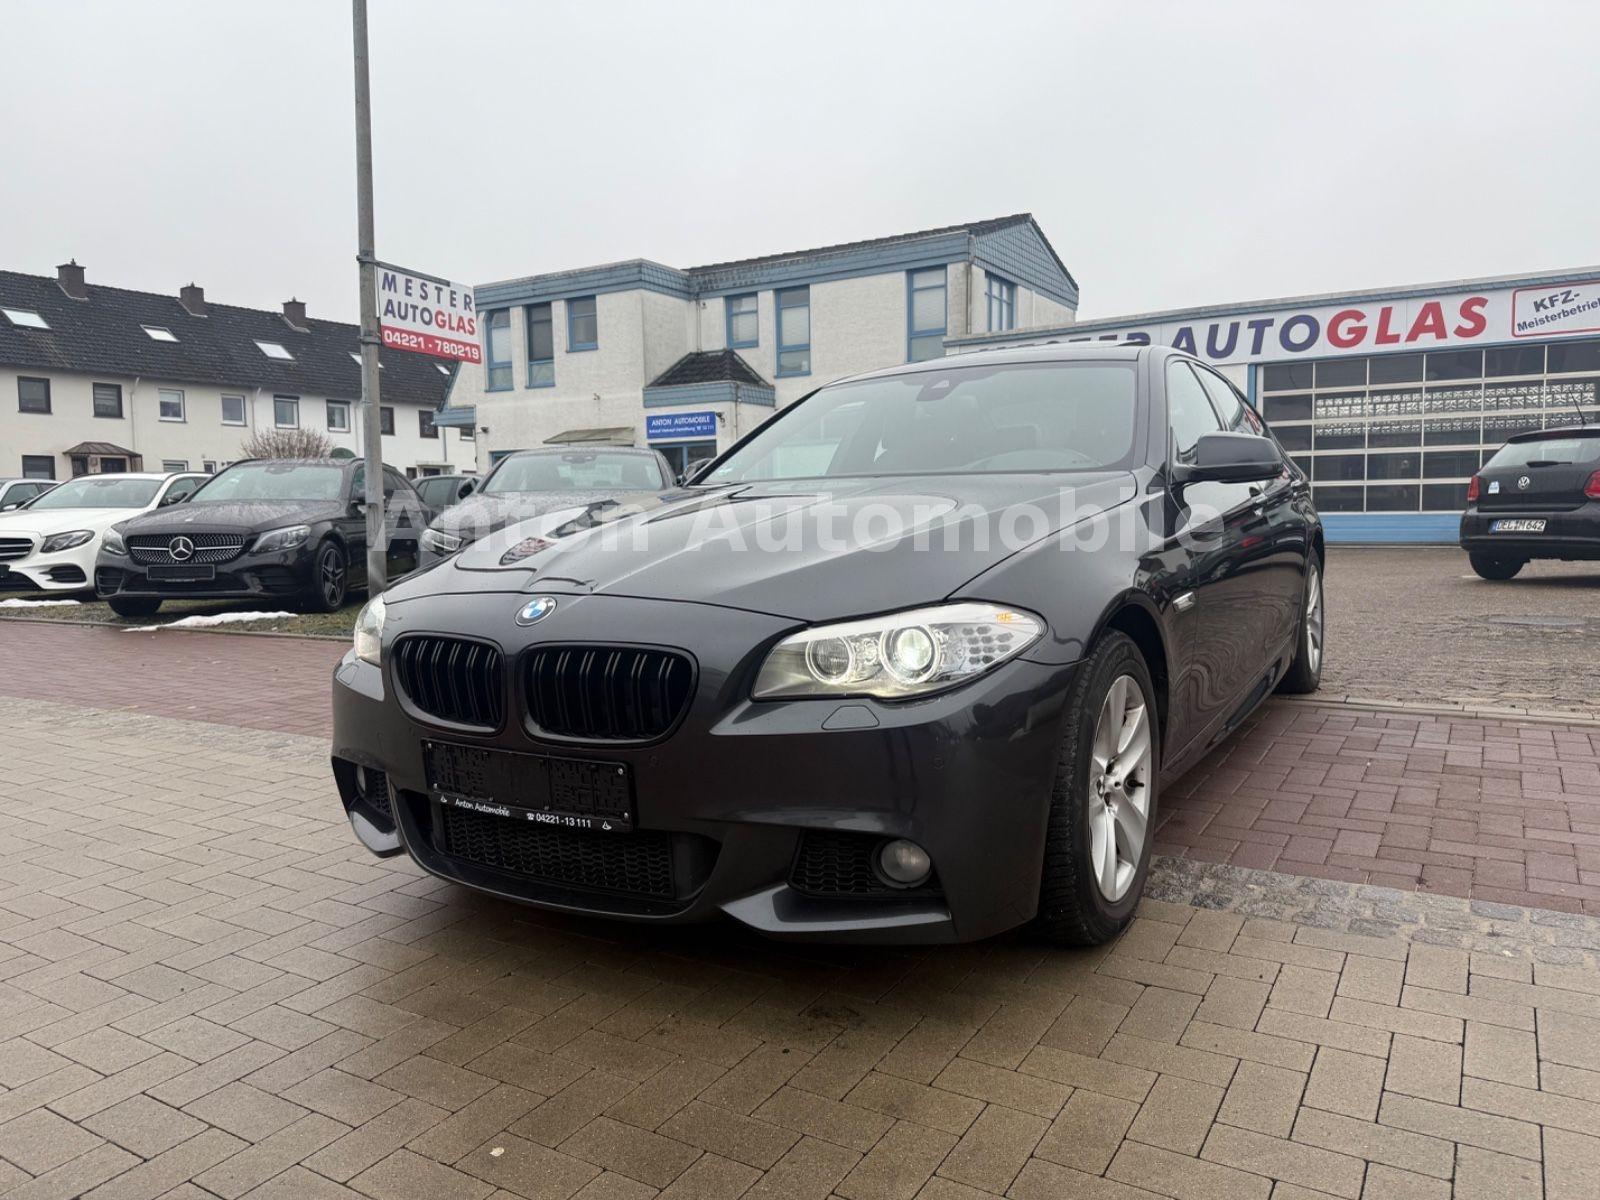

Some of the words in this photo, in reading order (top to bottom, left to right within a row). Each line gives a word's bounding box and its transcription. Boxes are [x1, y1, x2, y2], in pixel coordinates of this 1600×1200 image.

[382, 272, 472, 312] MESTER
[1534, 290, 1580, 312] KFZ-
[383, 299, 475, 335] AUTOGLAS
[1171, 297, 1488, 359] AUTOGLAS
[384, 330, 425, 349] 04221
[434, 340, 479, 360] 780219
[651, 418, 671, 427] ANTON
[674, 416, 710, 425] AUTOMOBILE
[455, 798, 474, 810] Anton
[474, 802, 511, 817] Automobile
